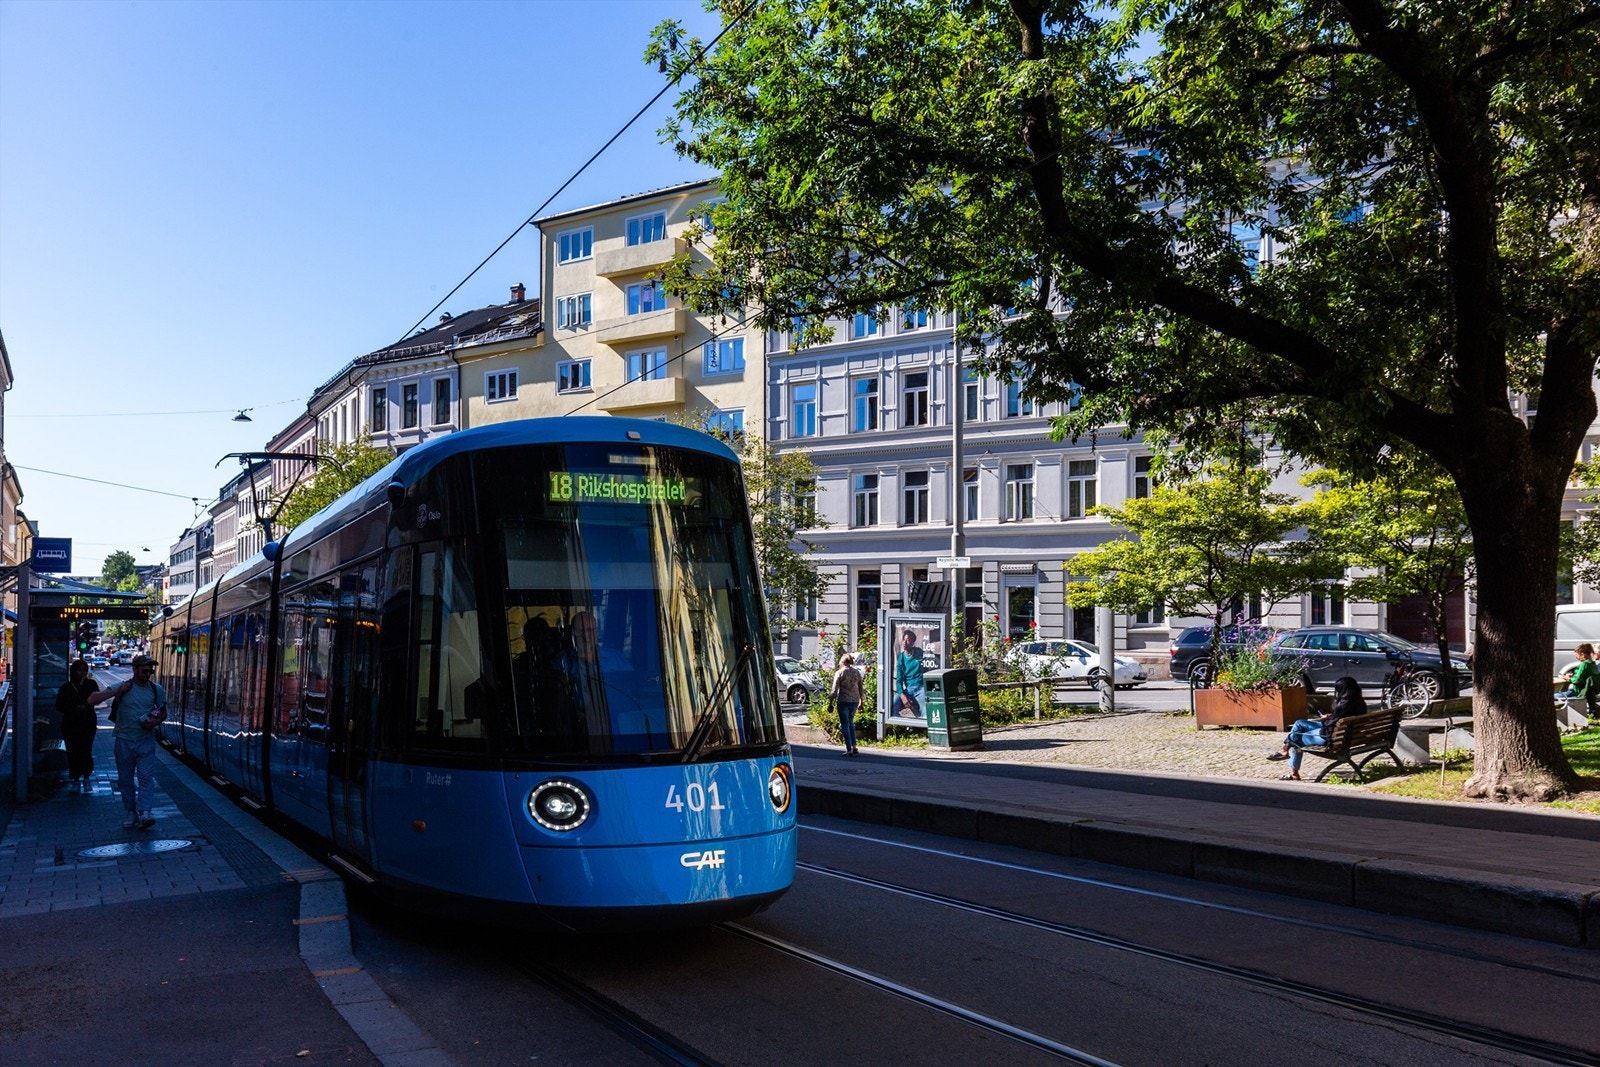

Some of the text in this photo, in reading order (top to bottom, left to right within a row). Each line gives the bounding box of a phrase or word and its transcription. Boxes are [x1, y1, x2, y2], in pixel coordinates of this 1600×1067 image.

[551, 474, 686, 504] 18 Rikshospitalet
[428, 510, 441, 520] Oslo
[895, 621, 940, 629] CARLINGS
[922, 641, 936, 651] Lee
[425, 771, 452, 786] Ruter#
[665, 781, 725, 813] 401
[680, 850, 726, 871] CAF
